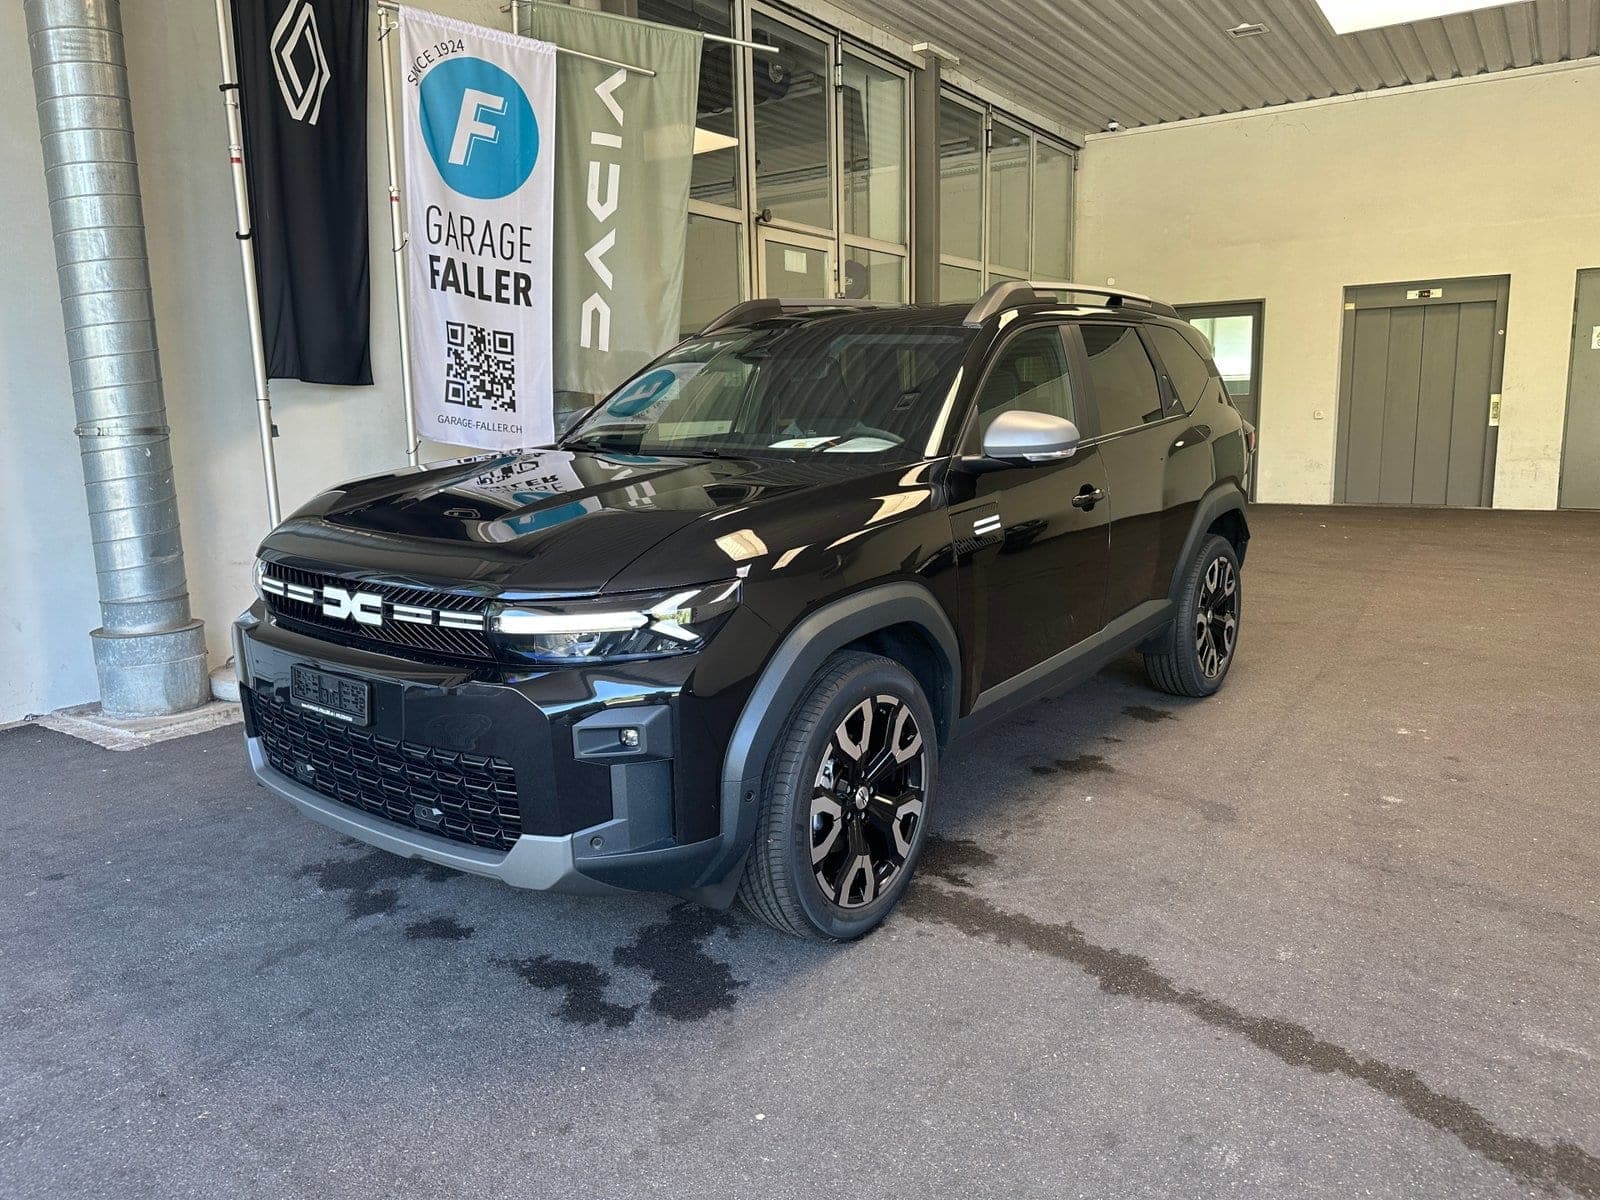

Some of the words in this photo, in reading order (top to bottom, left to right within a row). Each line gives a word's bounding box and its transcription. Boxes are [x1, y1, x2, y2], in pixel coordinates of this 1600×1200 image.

[407, 49, 435, 87] SINCE
[433, 39, 465, 58] 1924
[447, 87, 508, 167] F
[426, 204, 533, 264] GARAGE
[428, 254, 533, 307] FALLER
[437, 414, 523, 434] GARAGE-FALLER.CH
